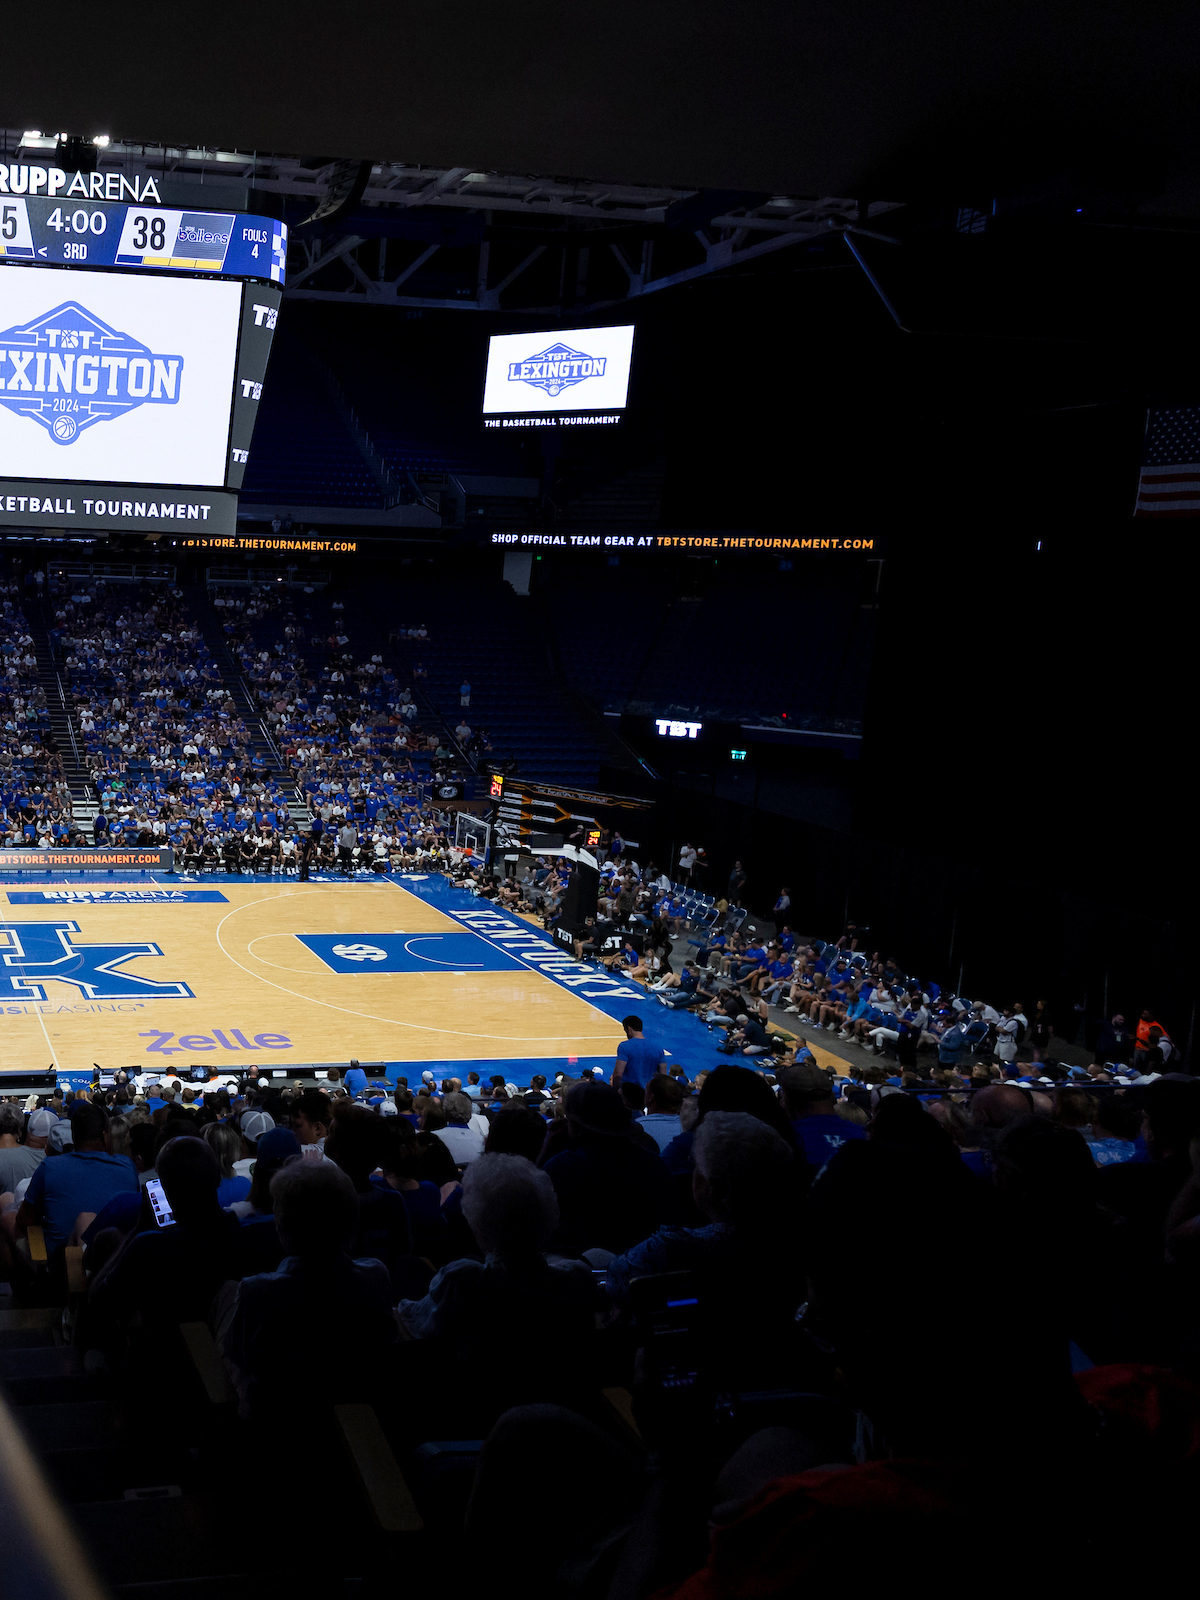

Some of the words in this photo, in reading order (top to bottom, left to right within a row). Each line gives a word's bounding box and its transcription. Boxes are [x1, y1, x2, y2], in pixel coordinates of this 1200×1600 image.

[46, 206, 107, 235] 4:00
[133, 216, 166, 251] 38
[178, 227, 229, 245] ballers
[242, 228, 268, 244] FOULS
[63, 242, 88, 260] 3RD
[251, 243, 259, 259] 4
[45, 328, 95, 350] TBT
[547, 352, 569, 361] TBT
[508, 358, 606, 380] LEXINGTON
[53, 398, 80, 413] 2024
[484, 419, 501, 428] THE
[502, 417, 557, 427] BASKETBALL
[559, 415, 621, 425] TOURNAMENT
[83, 499, 211, 520] TOURNAMENT
[491, 533, 518, 544] SHOP
[521, 534, 567, 545] OFFICIAL
[570, 535, 601, 546] TEAM
[604, 536, 635, 546] GEAR
[637, 536, 653, 546] AT
[657, 537, 874, 550] TBTSTORE.THETOURNAMENT.COM
[655, 718, 702, 739] TBT
[43, 891, 107, 899] RUPP
[109, 890, 188, 899] ARENA
[448, 909, 647, 1000] KENTUCKY
[138, 1028, 294, 1055] Zelle
